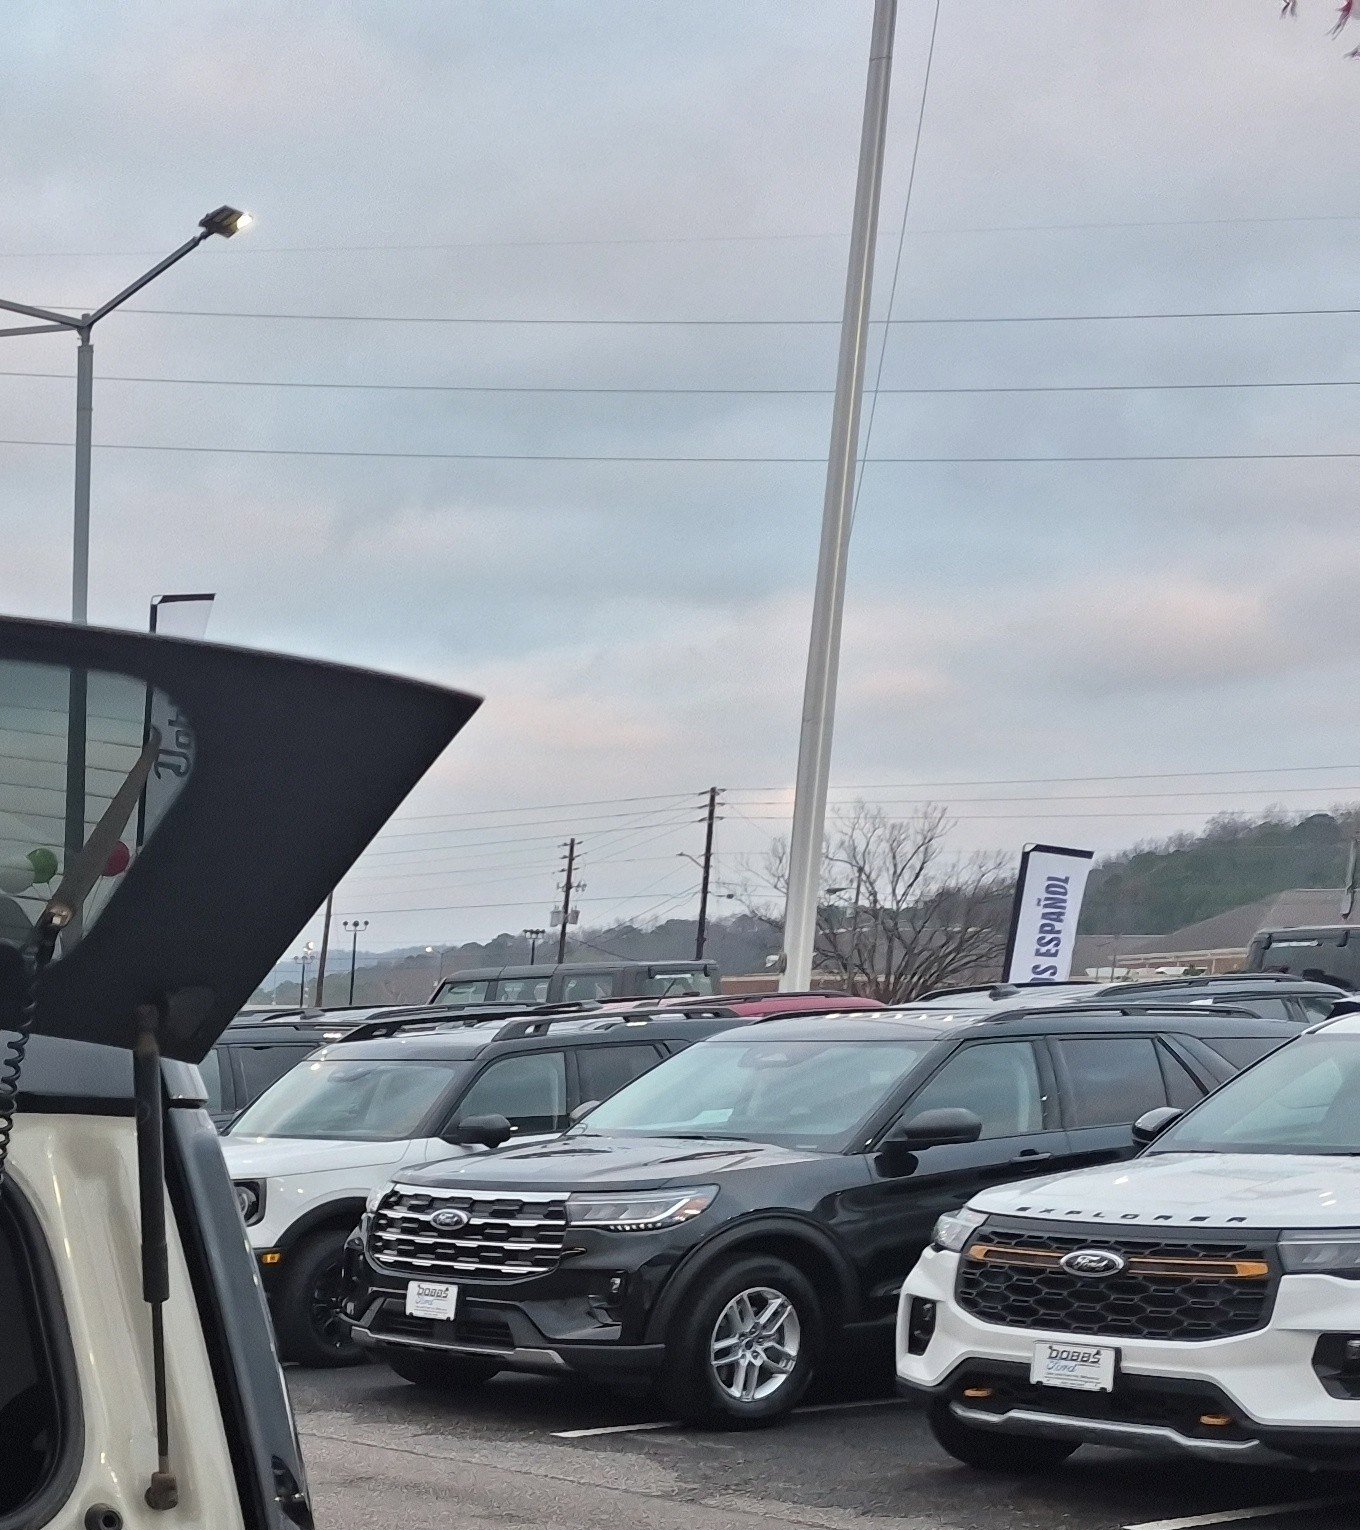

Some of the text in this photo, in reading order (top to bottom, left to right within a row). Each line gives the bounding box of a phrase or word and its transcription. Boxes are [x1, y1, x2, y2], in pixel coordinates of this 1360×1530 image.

[1035, 876, 1070, 957] ESPAÑOL
[1015, 1206, 1247, 1223] EXPLORER
[1047, 1347, 1101, 1364] DOBBS
